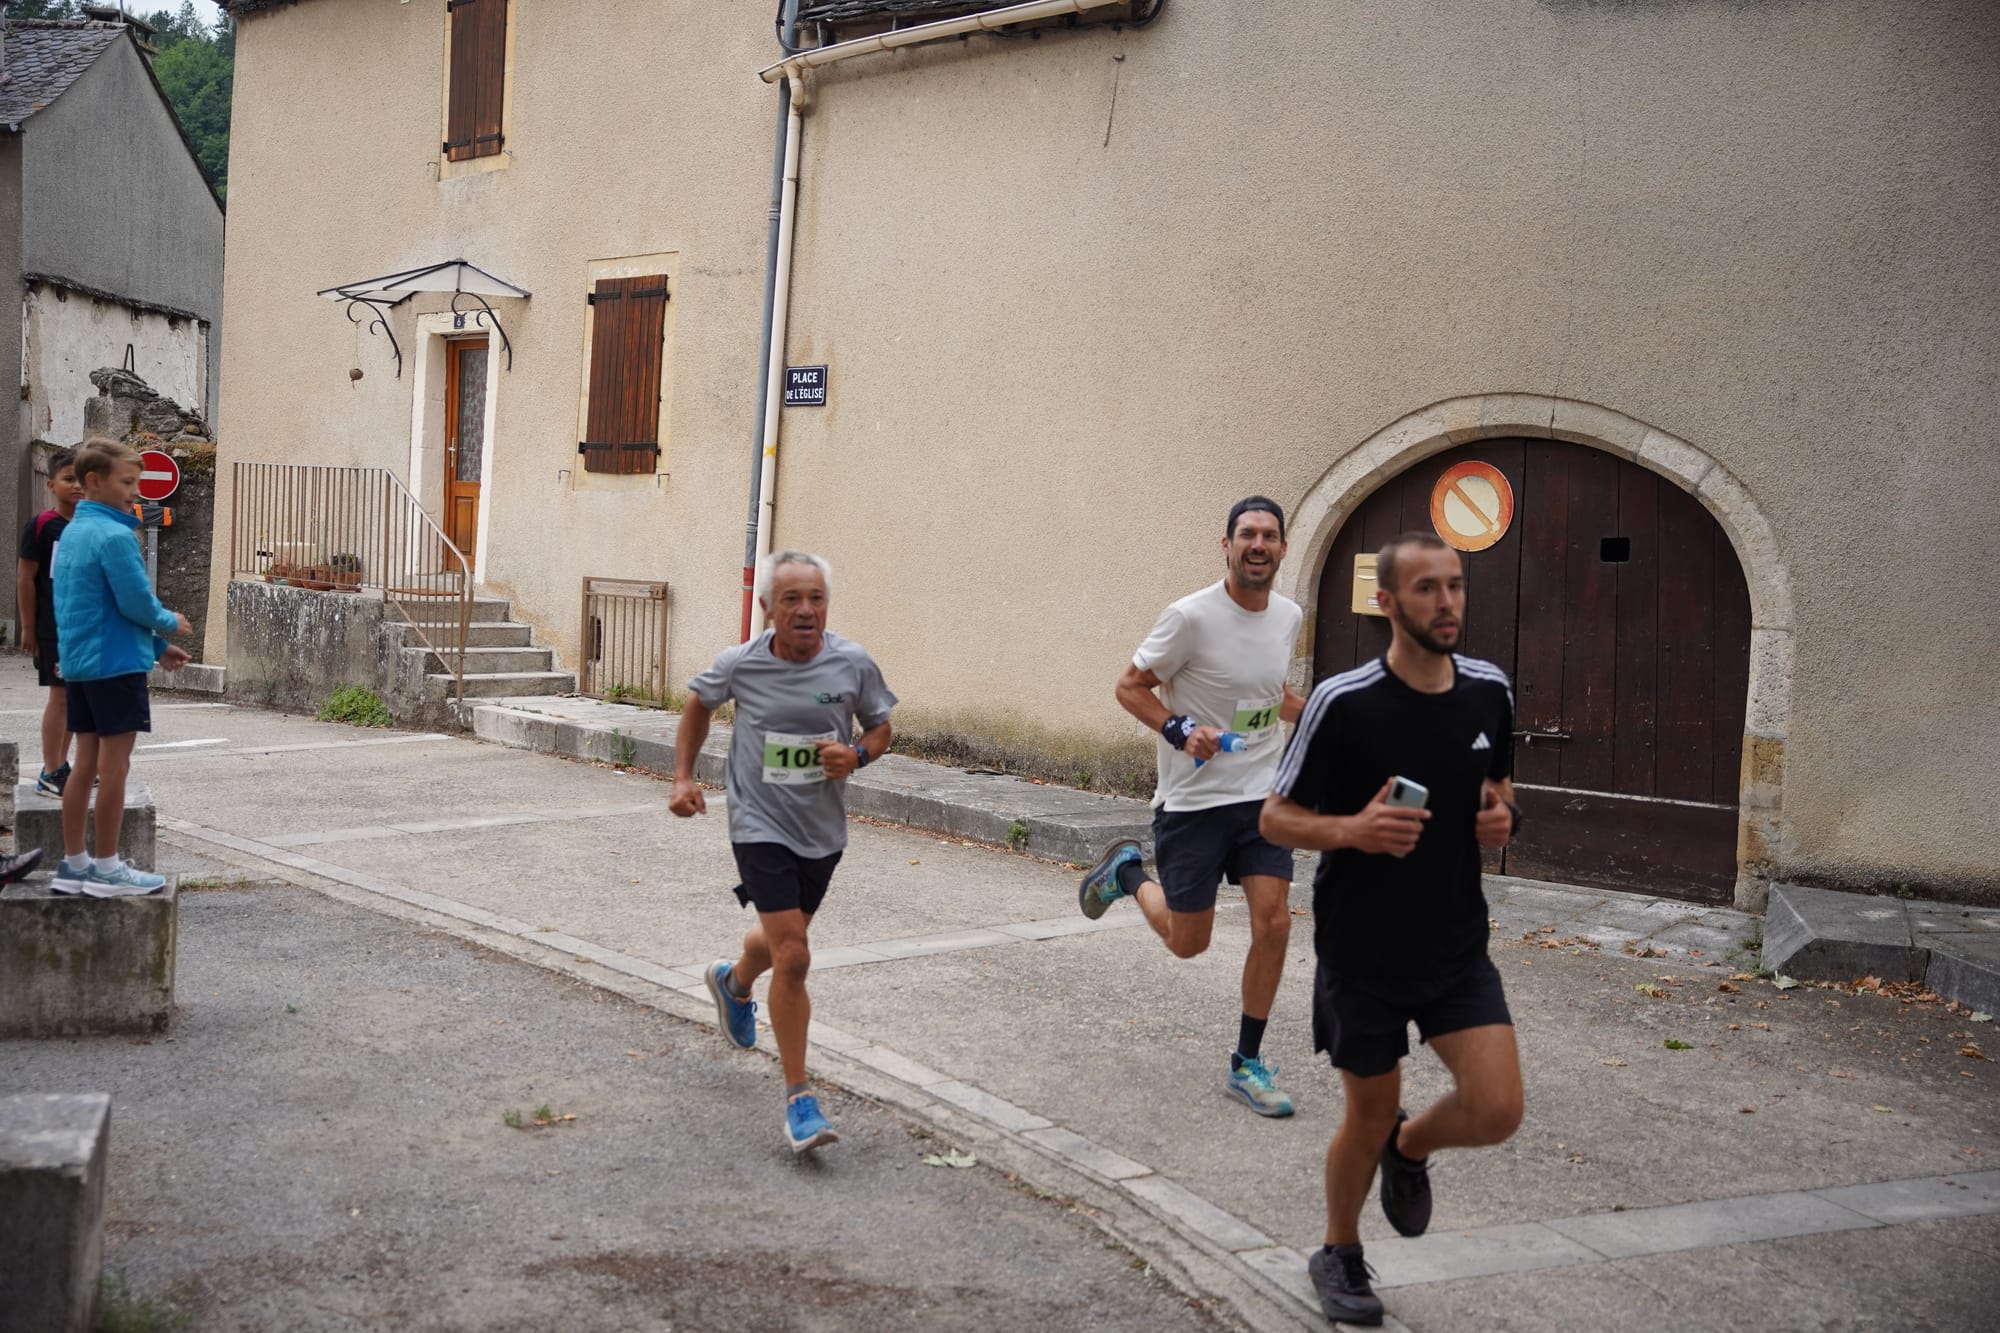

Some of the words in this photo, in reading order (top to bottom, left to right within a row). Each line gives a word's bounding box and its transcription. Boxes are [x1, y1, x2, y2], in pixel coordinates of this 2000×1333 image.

[792, 372, 819, 384] PLACE
[786, 390, 794, 400] DE
[1247, 709, 1272, 729] 41
